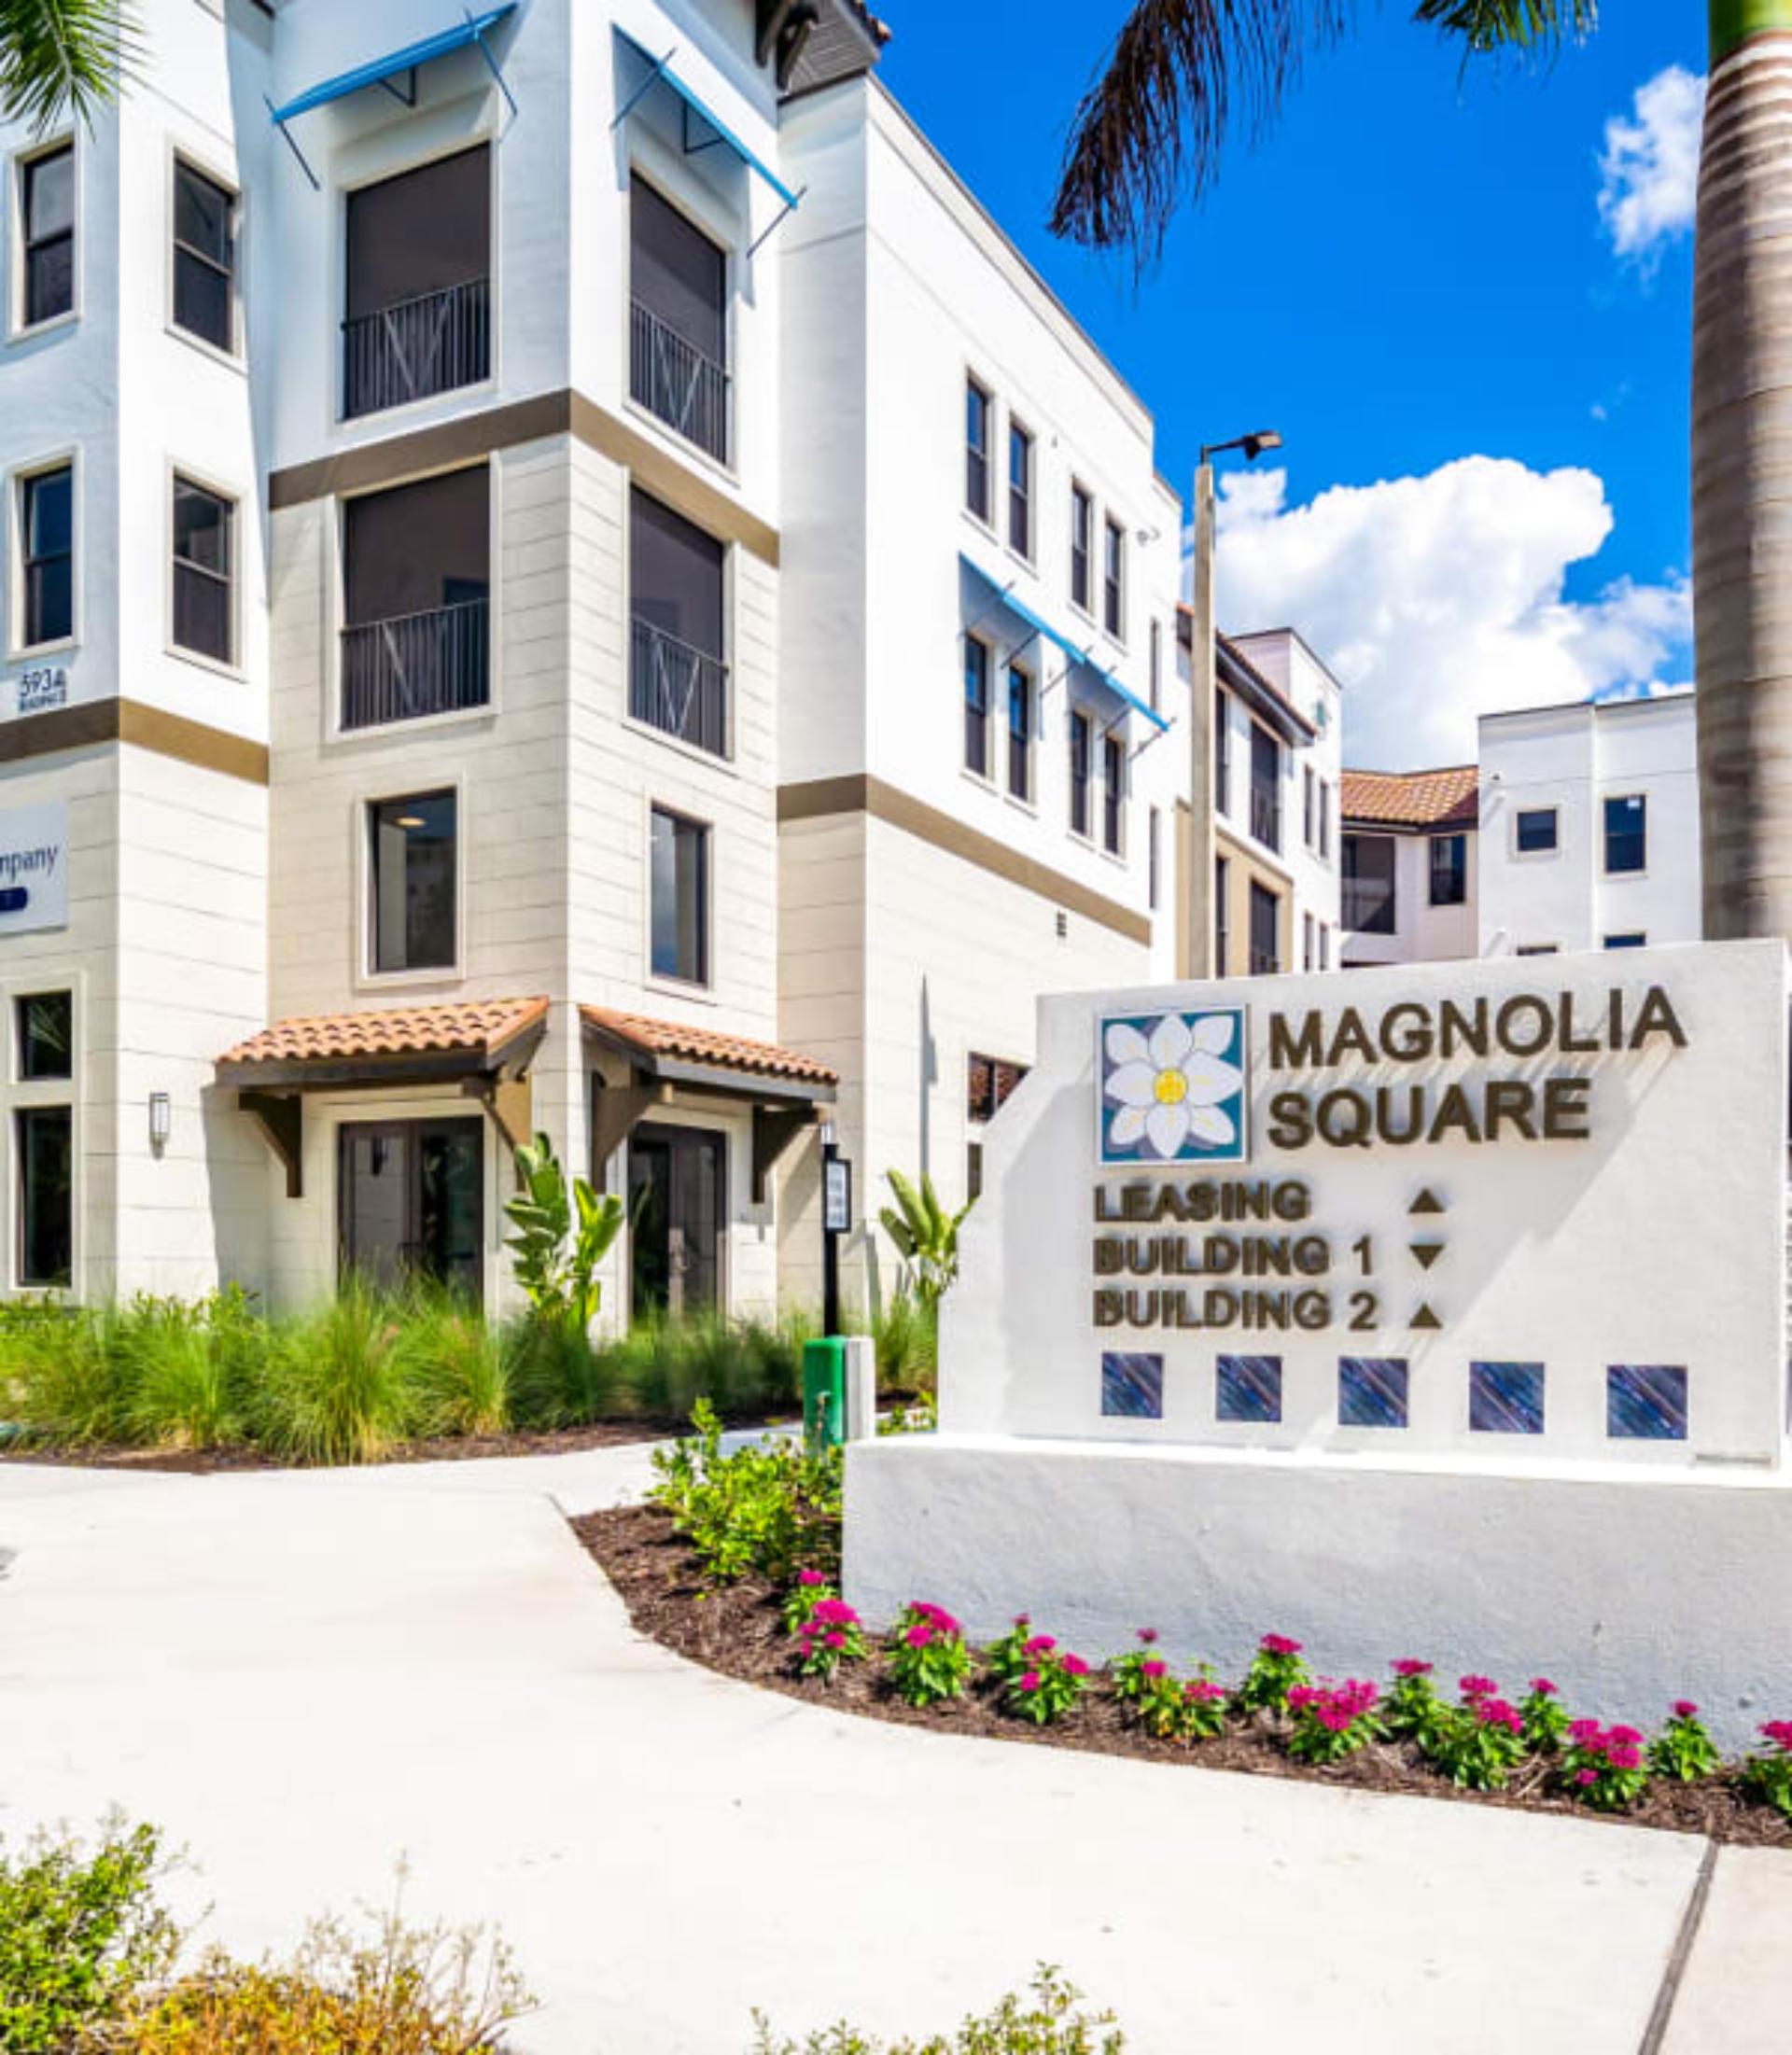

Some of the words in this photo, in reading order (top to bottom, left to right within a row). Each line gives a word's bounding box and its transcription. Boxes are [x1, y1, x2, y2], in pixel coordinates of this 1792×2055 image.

[1270, 987, 1687, 1069] MAGNOLIA
[1268, 1078, 1590, 1150] SQUARE
[1095, 1181, 1310, 1223] LEASING
[1094, 1234, 1329, 1276] BUILDING
[1353, 1237, 1371, 1275] 1
[1095, 1289, 1331, 1329] BUILDING
[1351, 1292, 1377, 1330] 2
